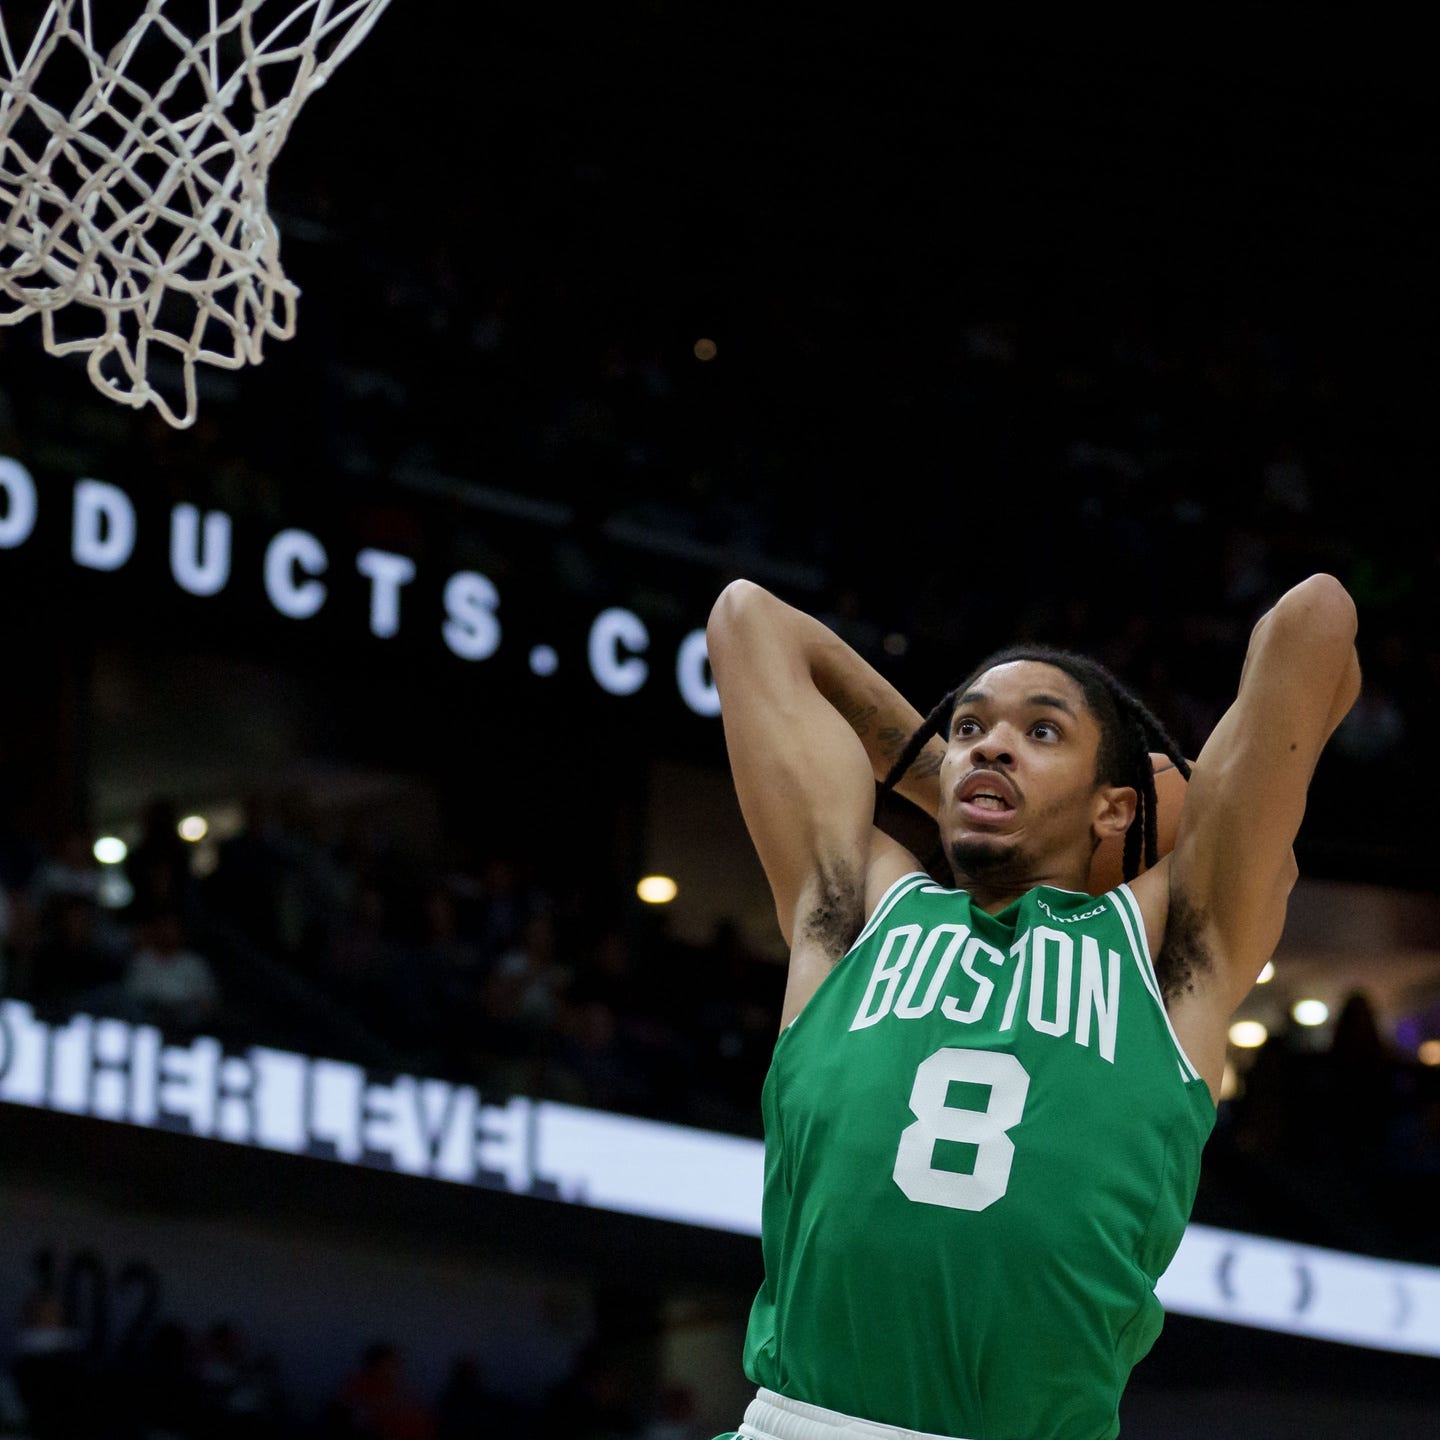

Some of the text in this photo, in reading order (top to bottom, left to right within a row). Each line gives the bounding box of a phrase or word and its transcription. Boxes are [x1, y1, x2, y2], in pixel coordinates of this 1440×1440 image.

[1037, 899, 1107, 923] Amica
[849, 923, 1121, 1064] BOSTON
[892, 1047, 1031, 1212] 8
